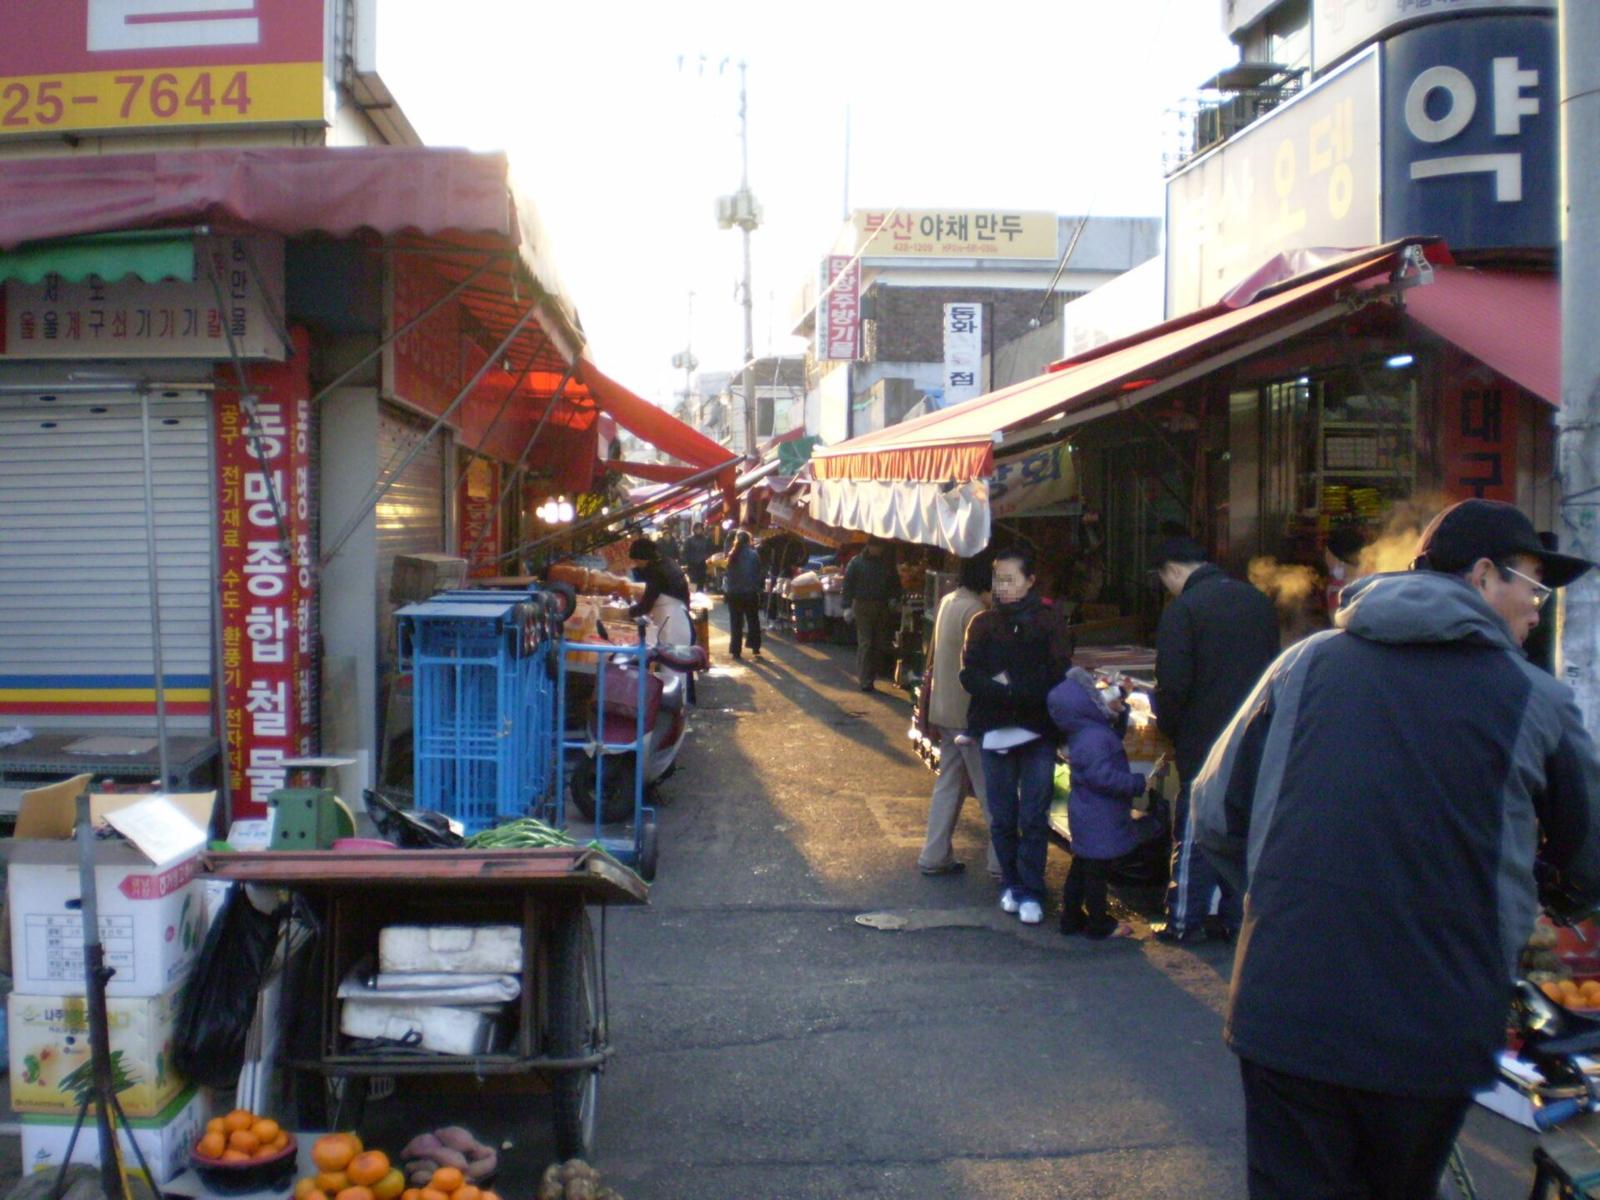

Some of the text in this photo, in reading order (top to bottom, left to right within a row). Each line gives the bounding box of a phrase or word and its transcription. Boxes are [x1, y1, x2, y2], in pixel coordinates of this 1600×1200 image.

[1, 71, 252, 127] 25-7644
[1404, 56, 1540, 202] 약
[863, 212, 1024, 242] 부산 야채 만두
[222, 466, 242, 548] 전기재료
